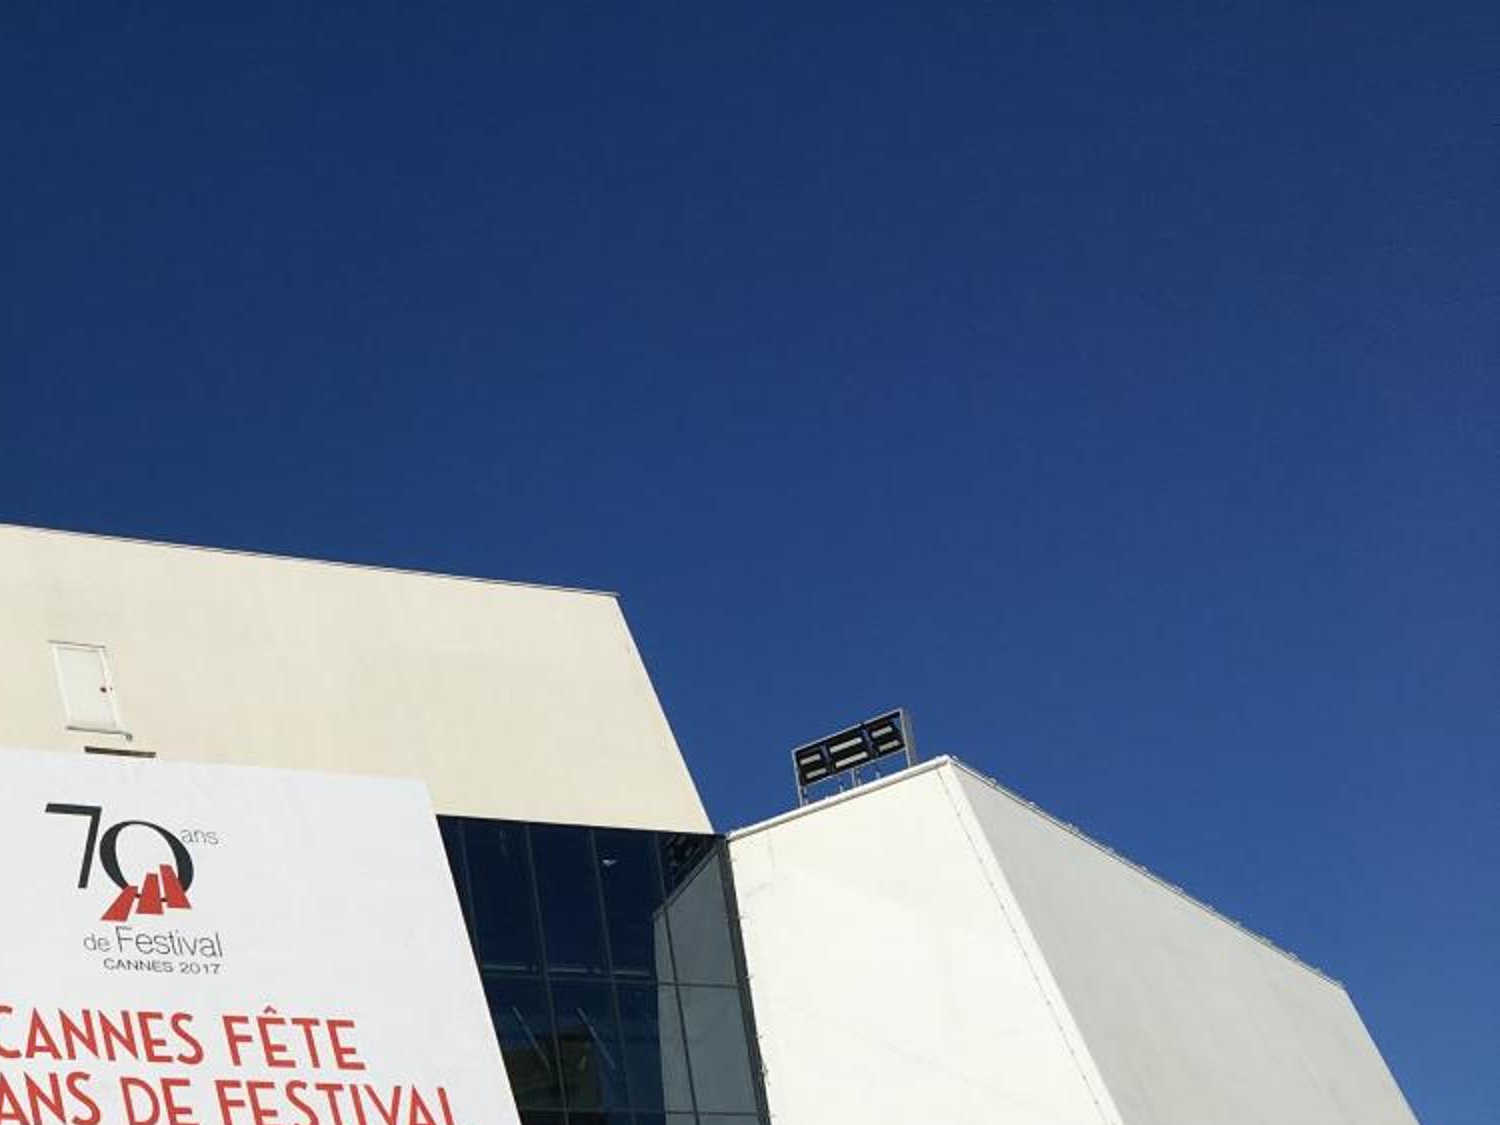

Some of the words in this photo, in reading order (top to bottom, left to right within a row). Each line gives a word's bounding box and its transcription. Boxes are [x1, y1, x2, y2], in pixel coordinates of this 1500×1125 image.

[44, 801, 195, 905] 70
[181, 828, 220, 846] ans
[84, 933, 111, 953] de
[114, 925, 224, 959] Festival
[103, 957, 174, 974] CANNES
[179, 961, 221, 976] 2017
[222, 1005, 366, 1071] FÊTE
